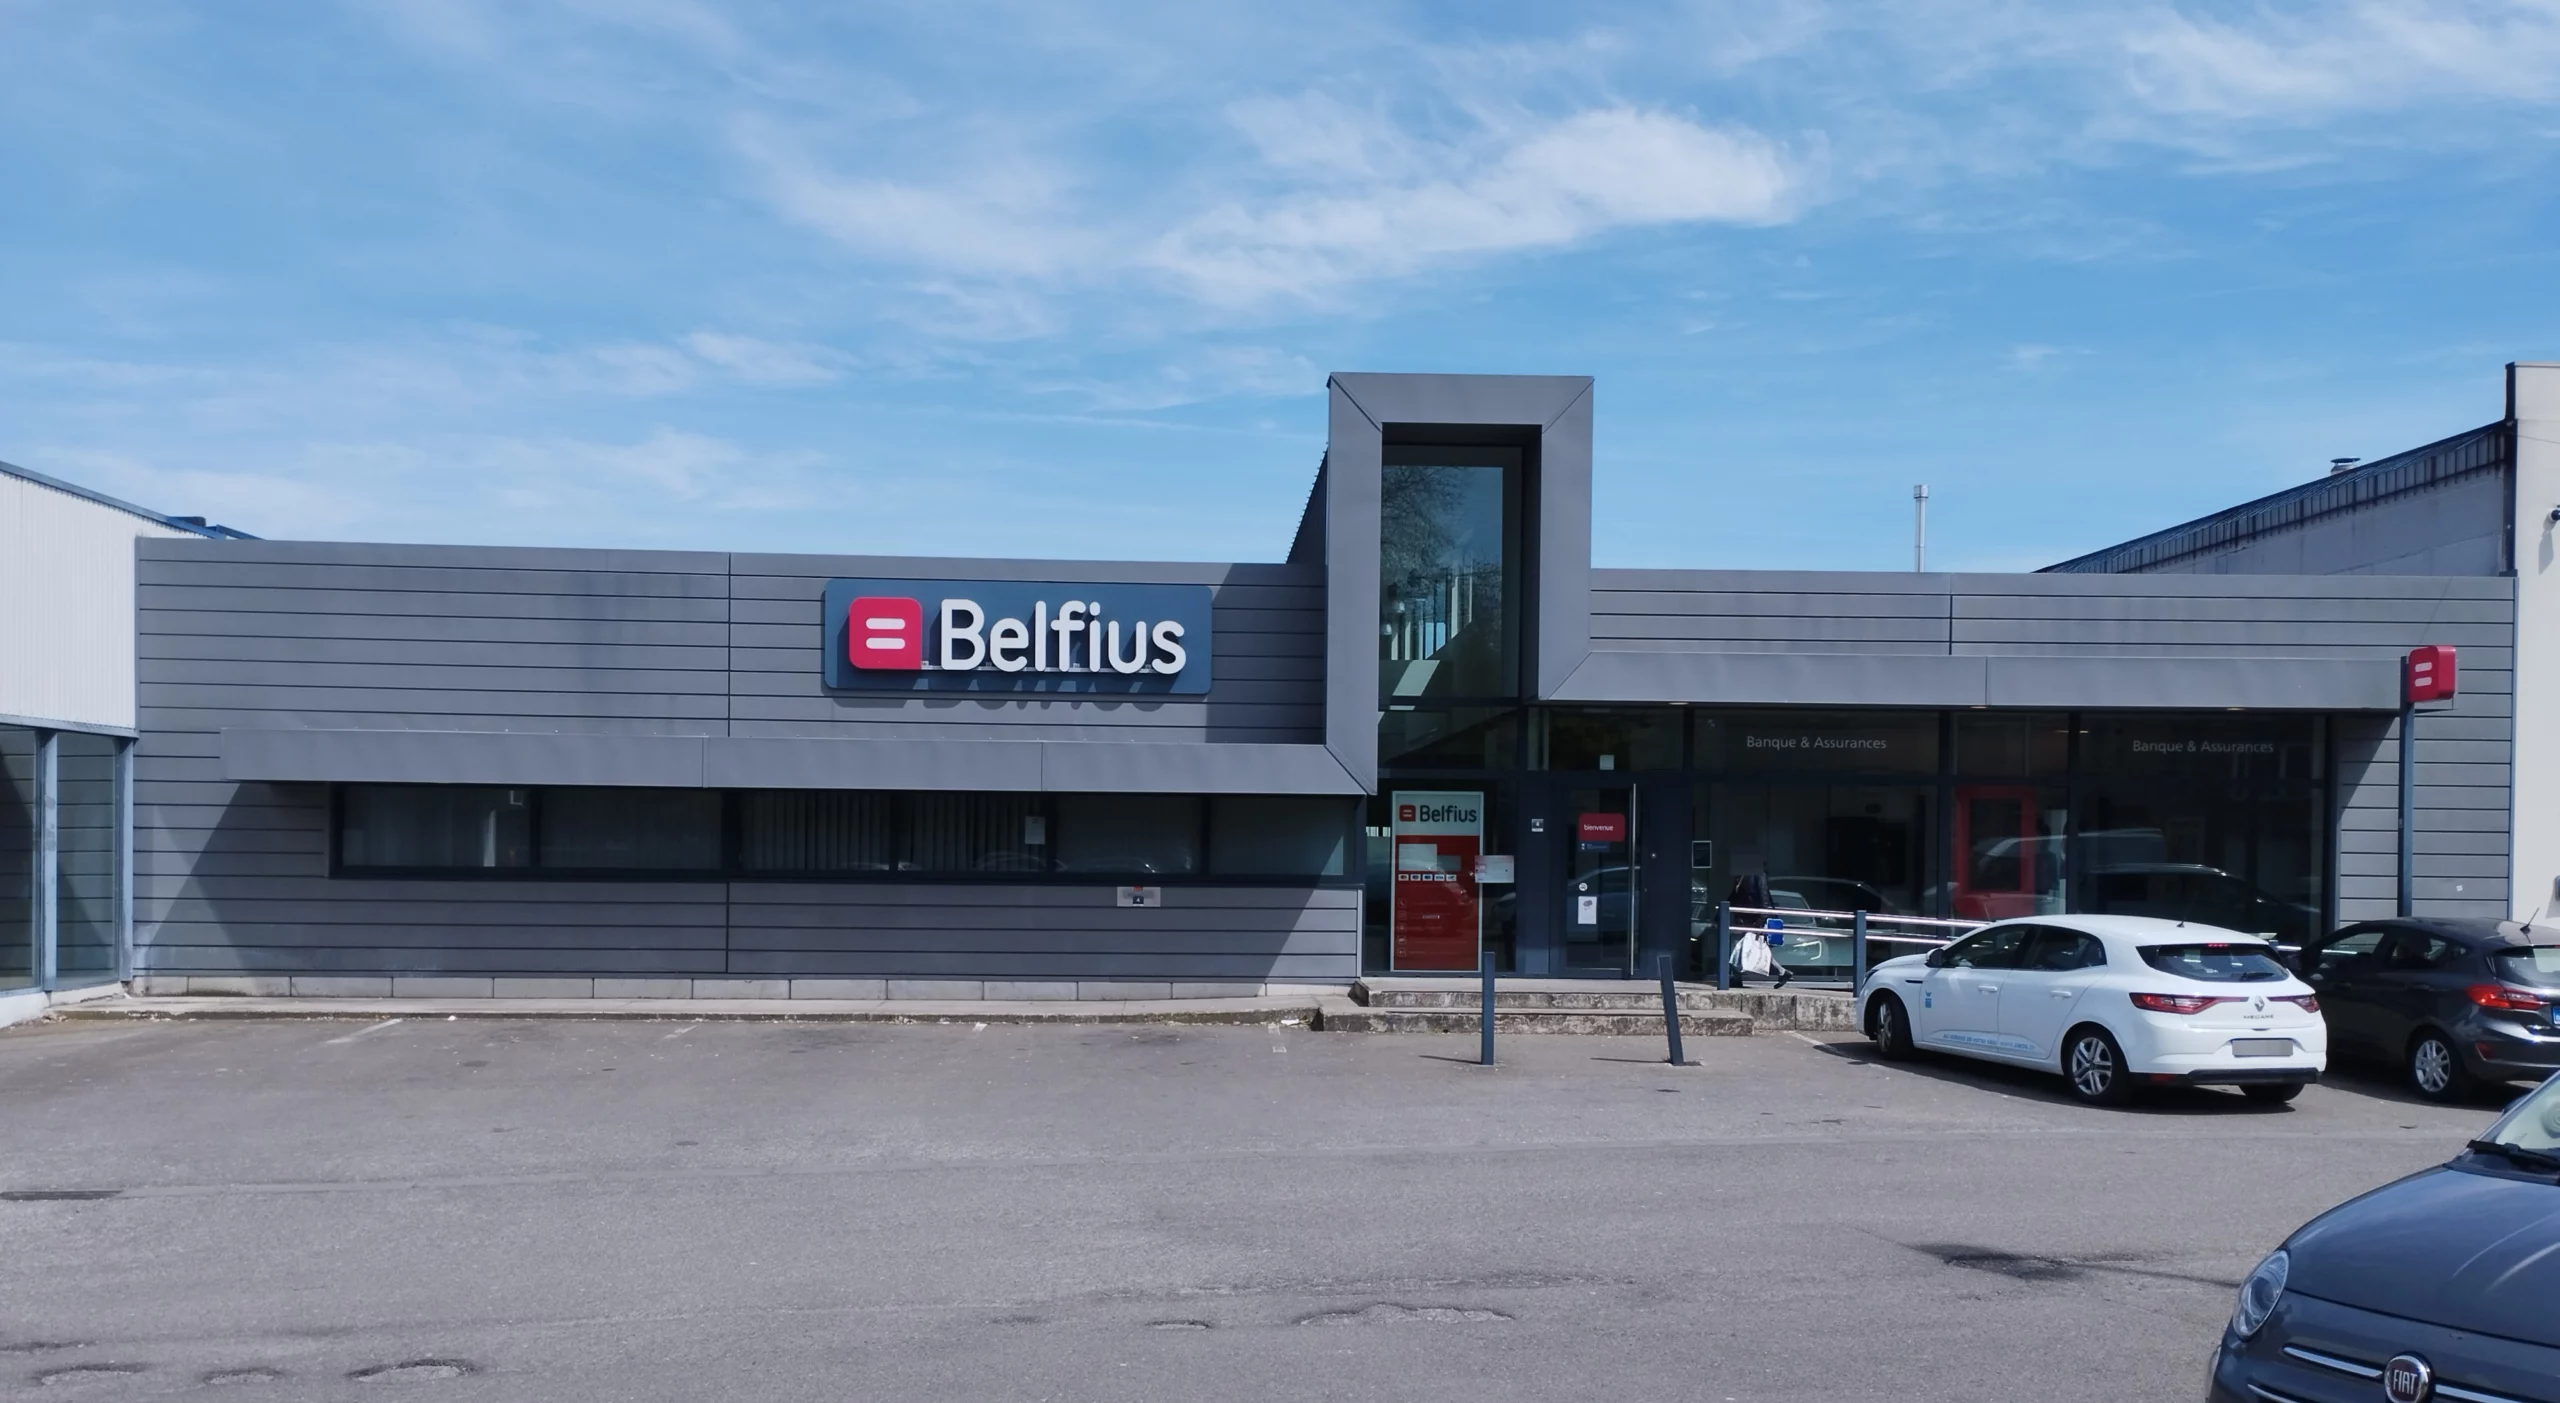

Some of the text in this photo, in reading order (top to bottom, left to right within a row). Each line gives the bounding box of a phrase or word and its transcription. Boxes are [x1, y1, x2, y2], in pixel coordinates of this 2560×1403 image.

[941, 599, 1187, 674] Belfius
[1746, 736, 1887, 751] Banque & Assurances
[2132, 740, 2274, 754] Banque & Assurances
[1419, 804, 1477, 823] Belfius
[1583, 824, 1614, 832] bienvenue
[2393, 1369, 2418, 1395] FIAT
